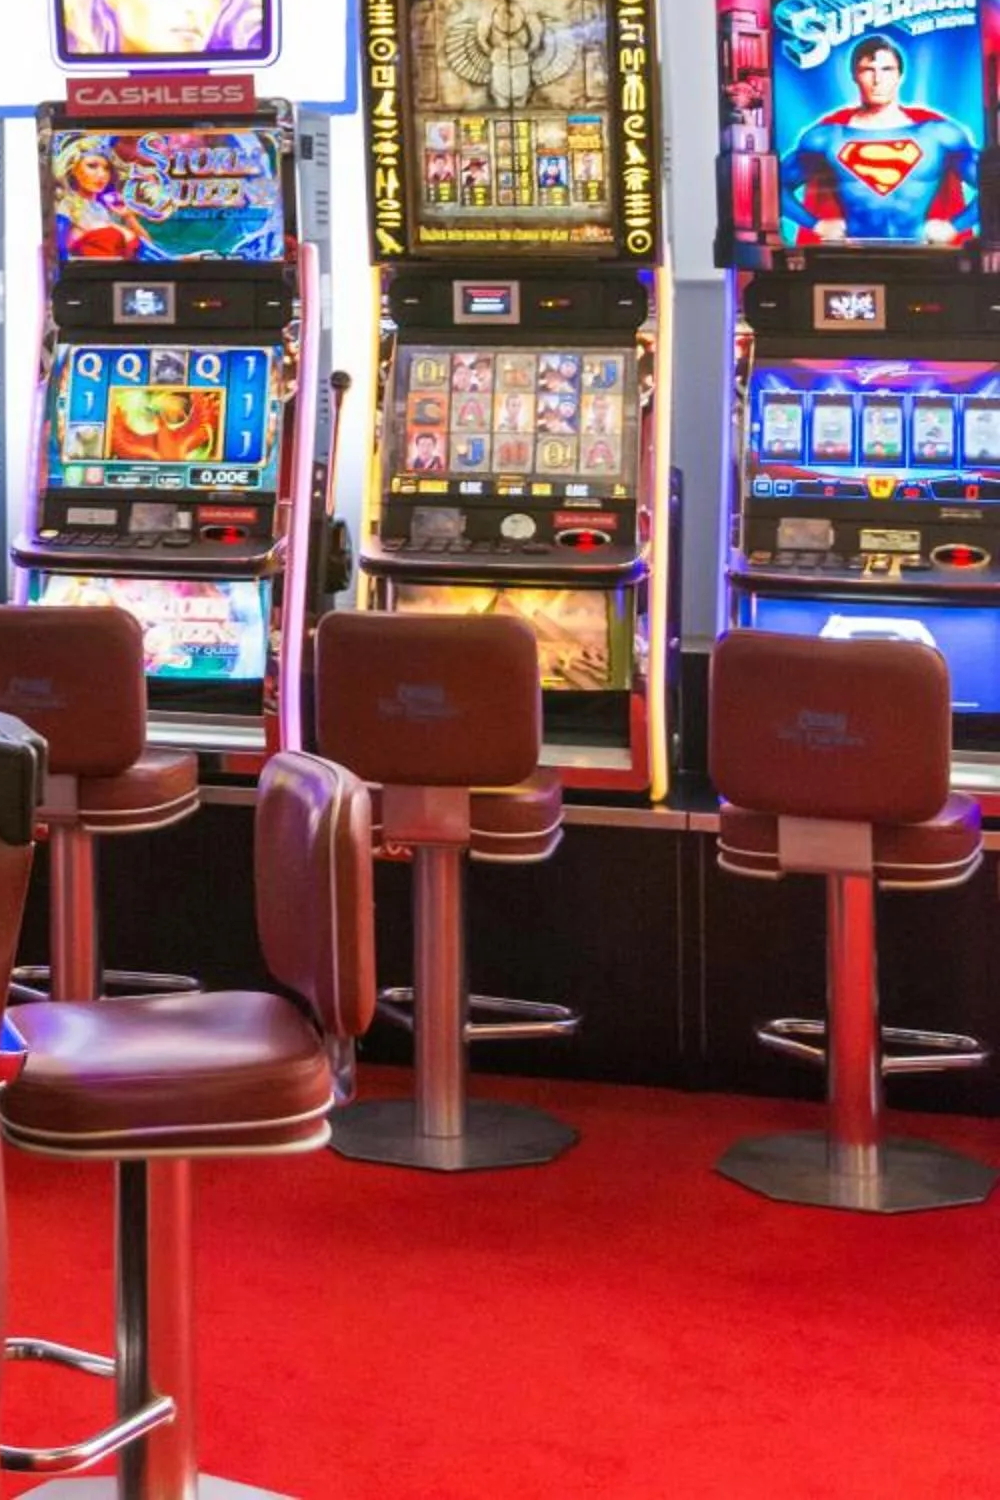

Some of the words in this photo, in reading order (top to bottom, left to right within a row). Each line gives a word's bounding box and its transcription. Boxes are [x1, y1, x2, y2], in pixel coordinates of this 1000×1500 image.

[74, 84, 244, 106] CASHLESS
[77, 352, 103, 382] Q
[116, 352, 142, 382] Q
[195, 353, 220, 383] Q
[200, 470, 250, 485] 0,00€
